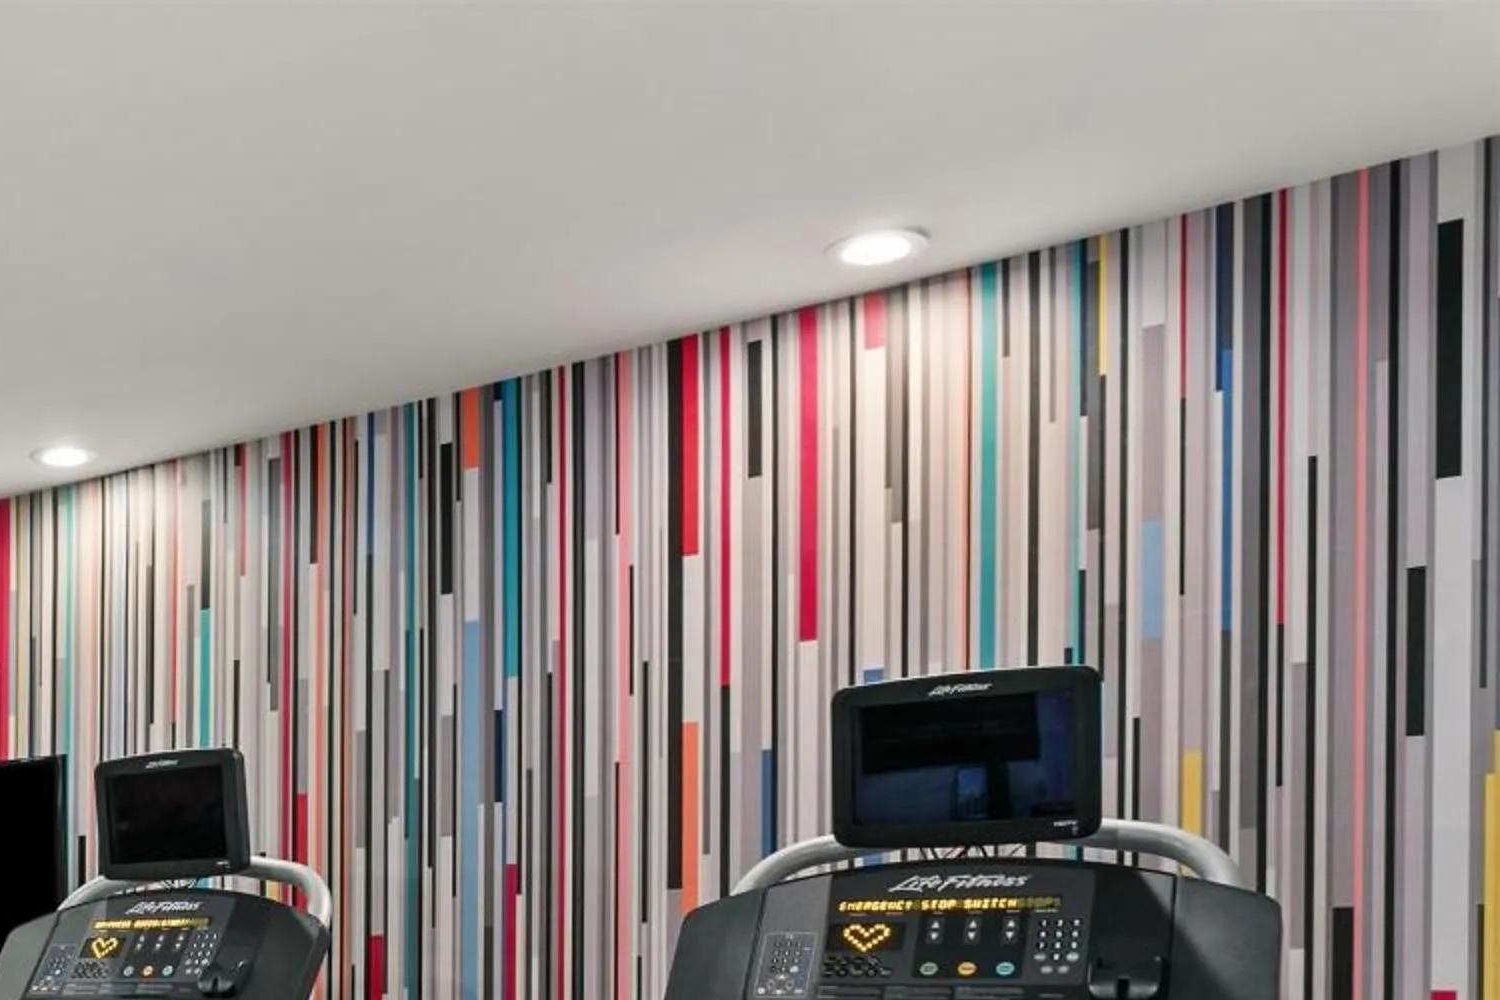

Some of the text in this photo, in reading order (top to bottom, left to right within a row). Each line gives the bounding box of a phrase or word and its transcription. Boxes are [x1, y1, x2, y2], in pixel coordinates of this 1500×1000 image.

[888, 874, 1032, 892] Life Fitness
[839, 900, 913, 911] EMERGENCY
[921, 899, 957, 910] STOP
[963, 898, 1018, 909] SWITCH
